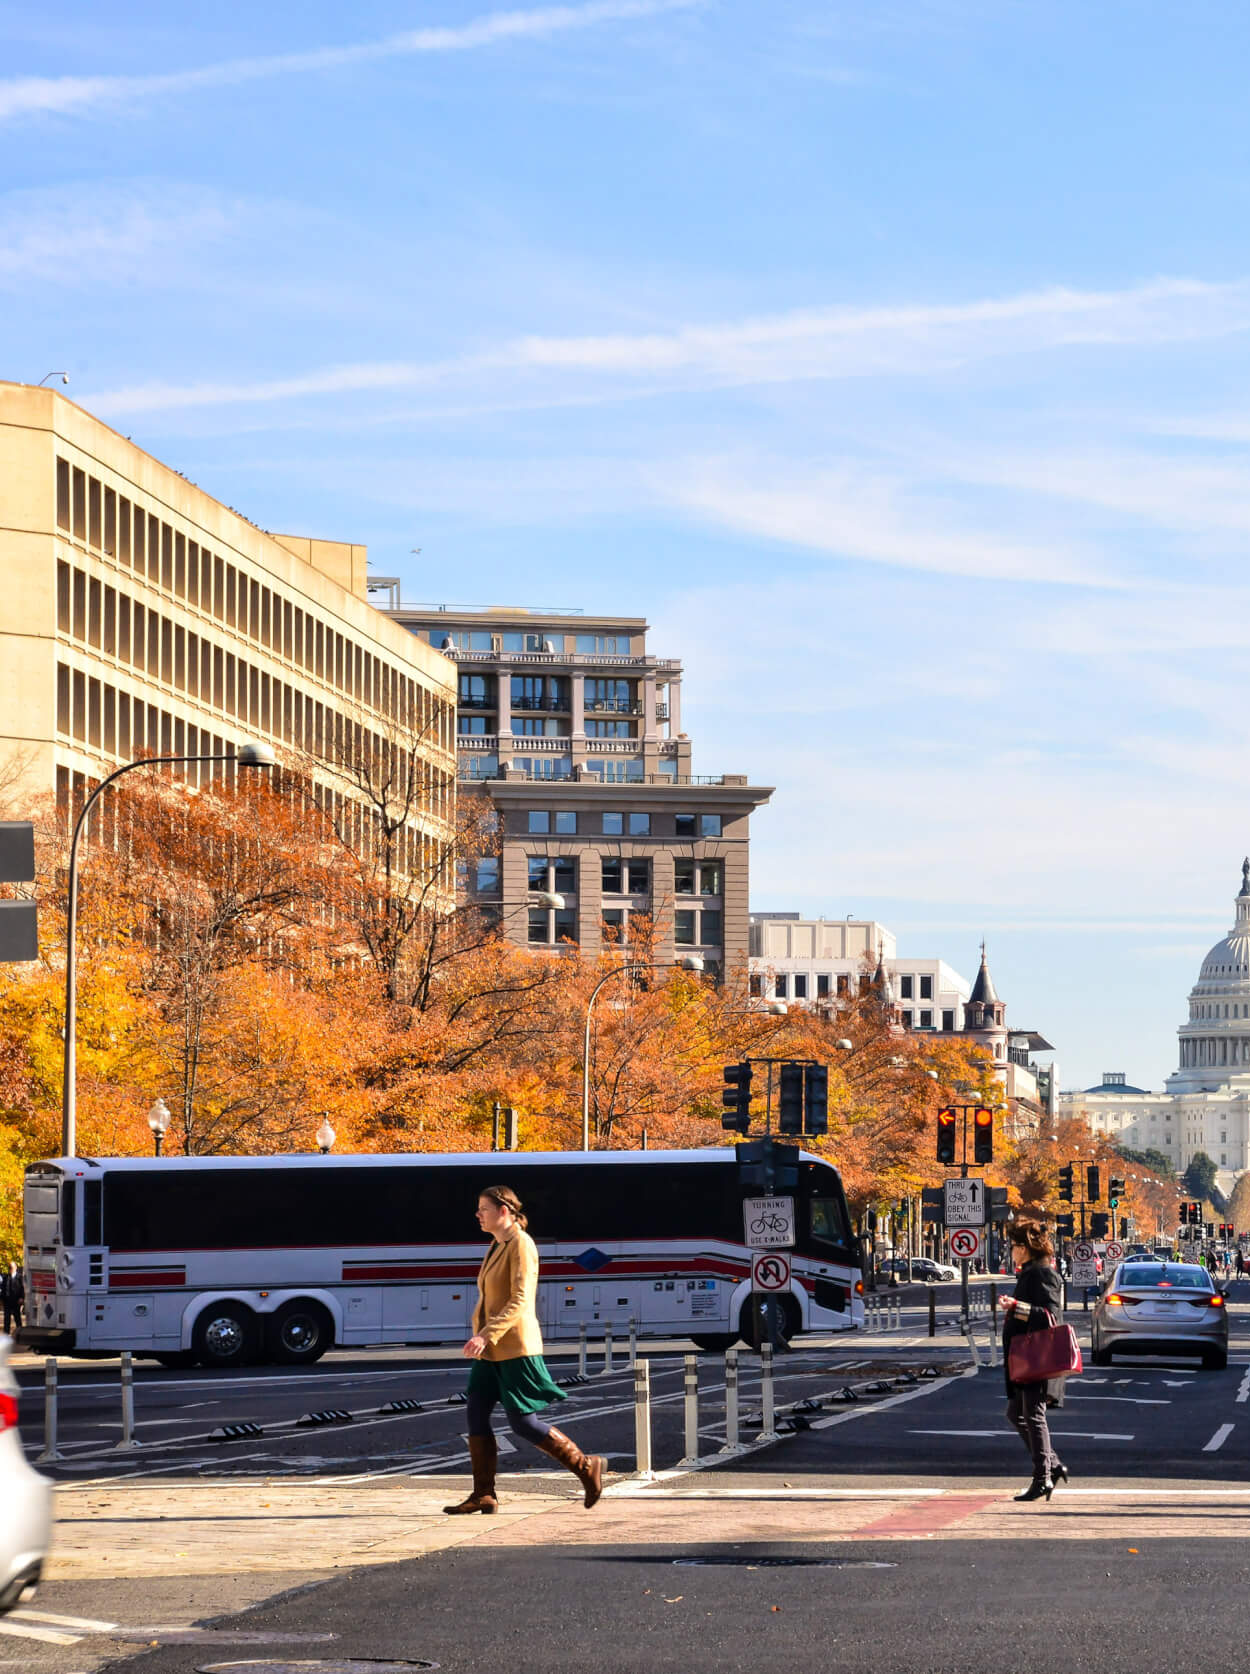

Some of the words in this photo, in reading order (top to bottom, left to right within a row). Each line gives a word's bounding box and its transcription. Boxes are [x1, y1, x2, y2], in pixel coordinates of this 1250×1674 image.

[948, 1181, 965, 1189] THRU
[752, 1201, 785, 1209] TURNING
[948, 1213, 970, 1221] SIGNAL
